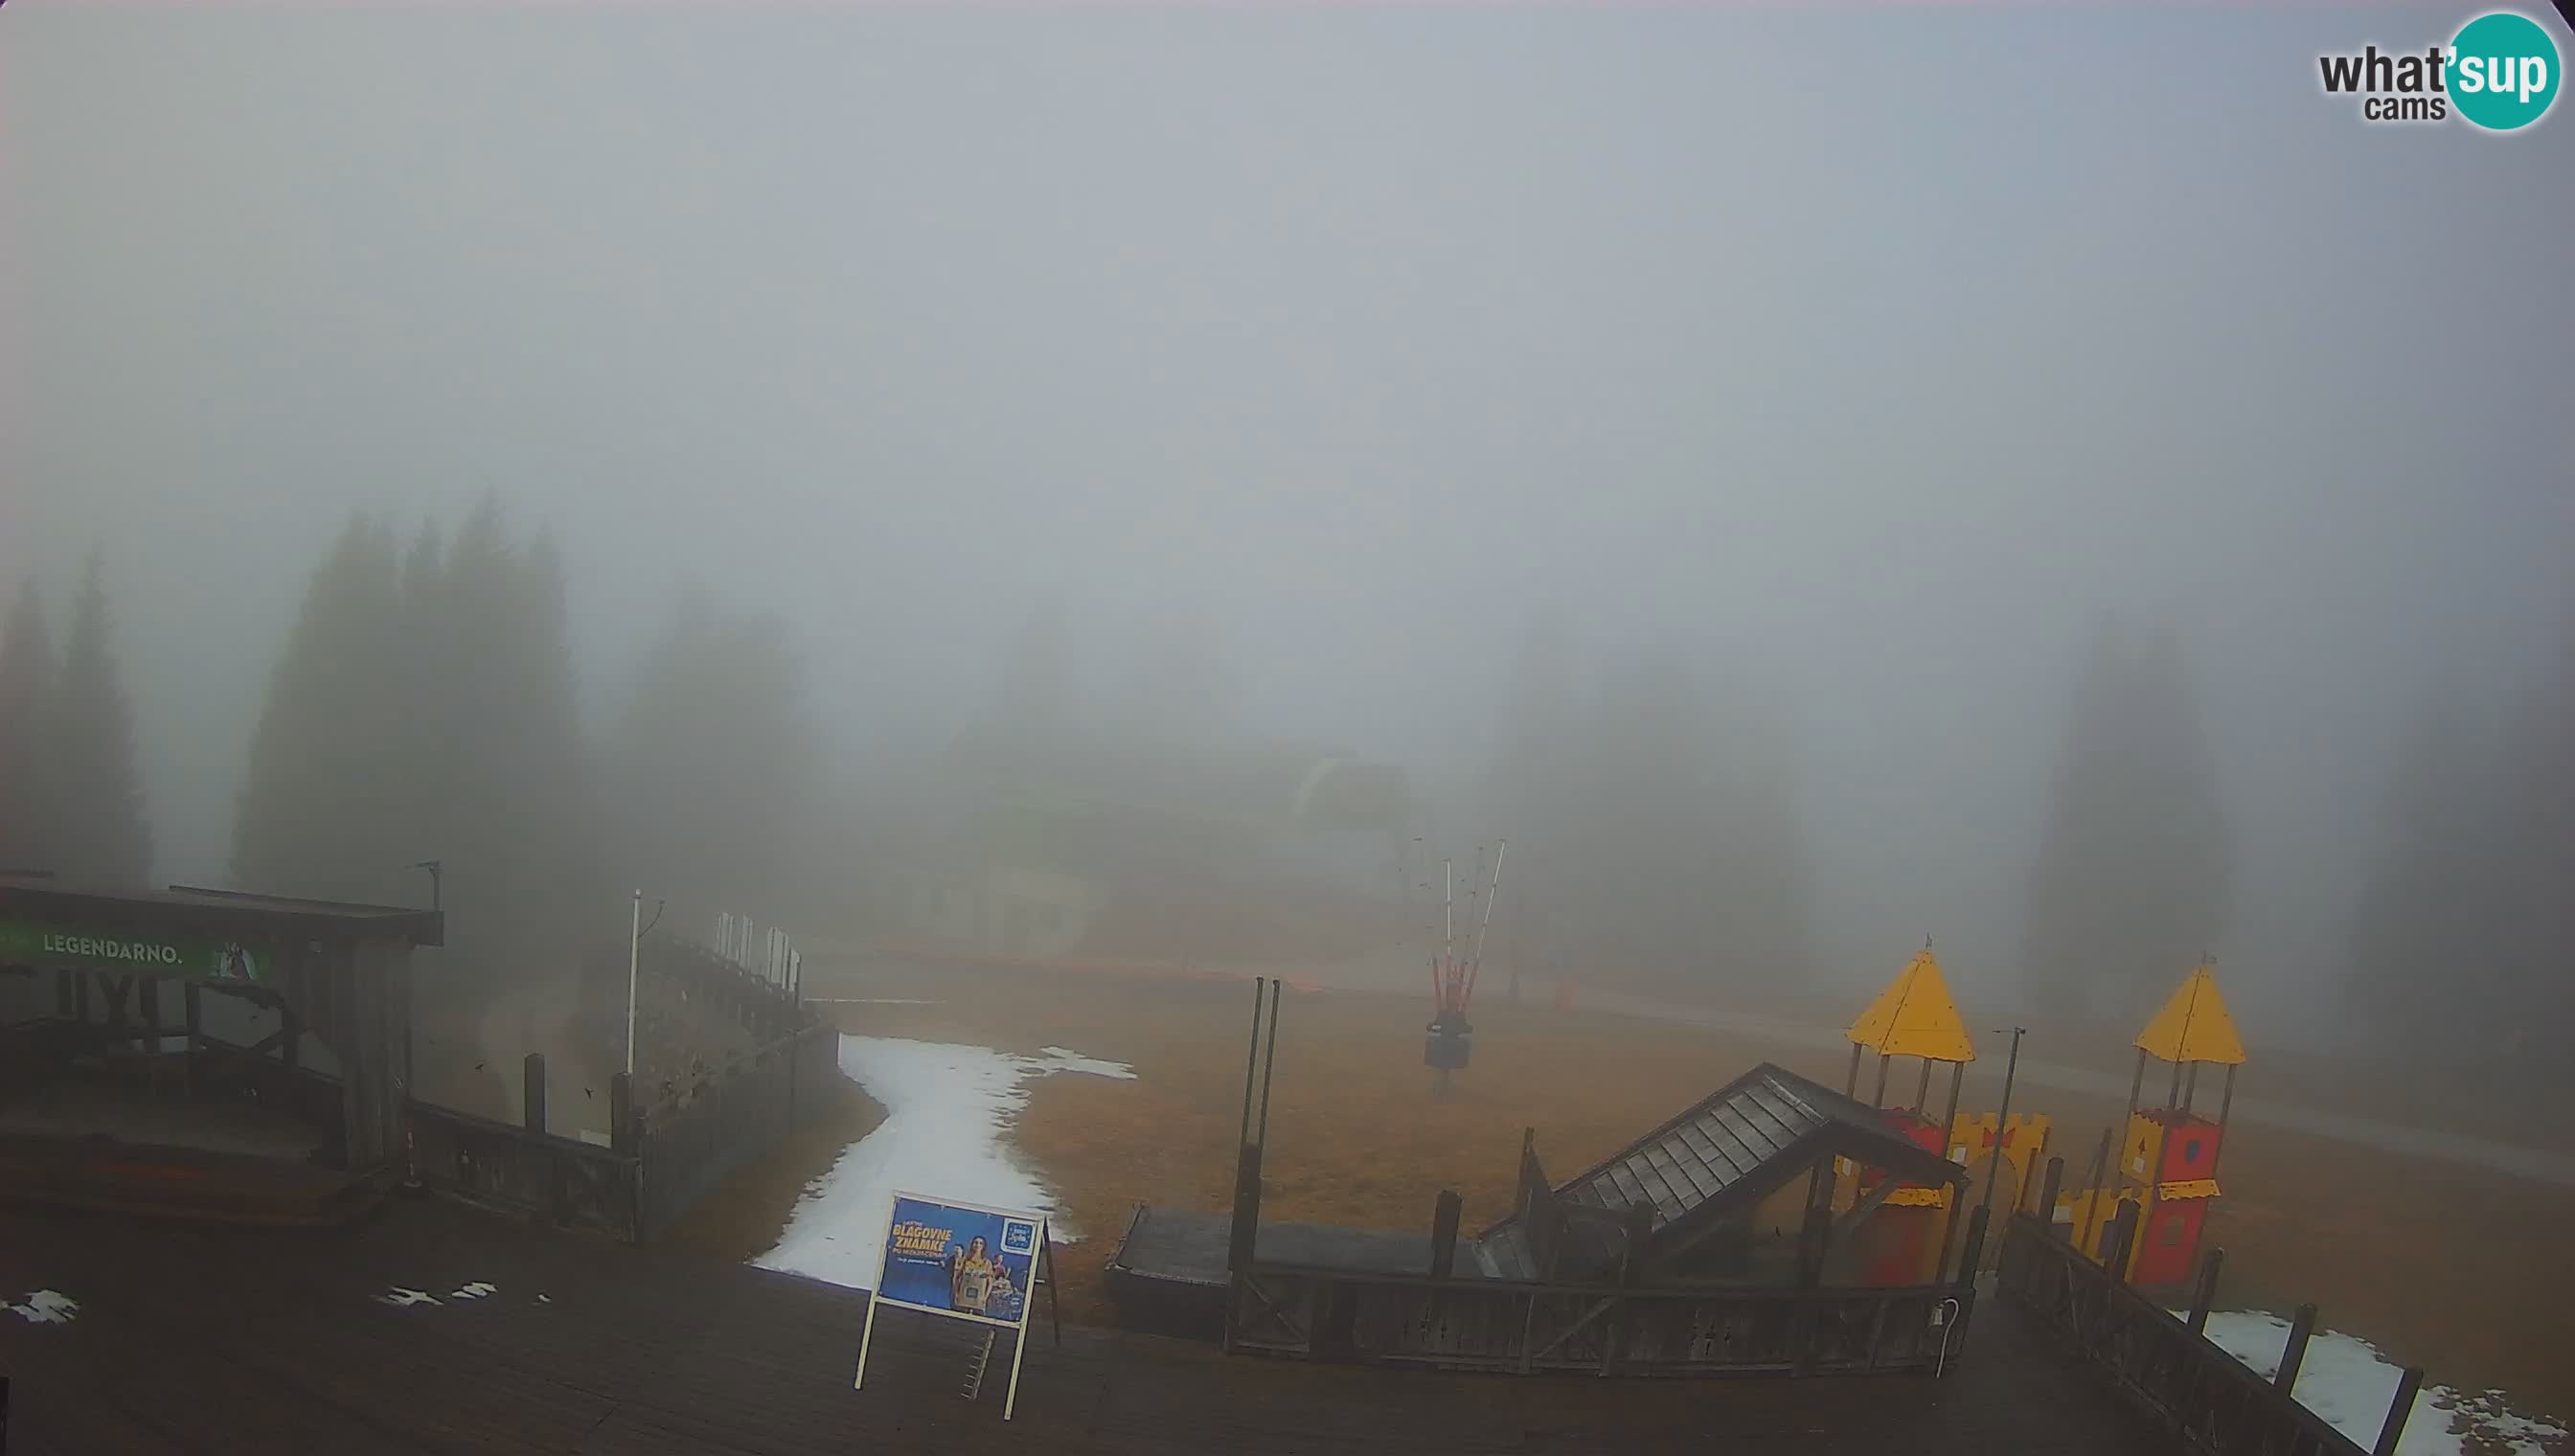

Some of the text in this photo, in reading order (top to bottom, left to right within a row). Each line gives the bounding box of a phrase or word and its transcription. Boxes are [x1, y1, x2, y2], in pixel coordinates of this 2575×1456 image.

[44, 934, 183, 965] LEGENDARNO.
[893, 1224, 952, 1240] BLAGOVNE
[895, 1237, 946, 1252] ZNAMKE
